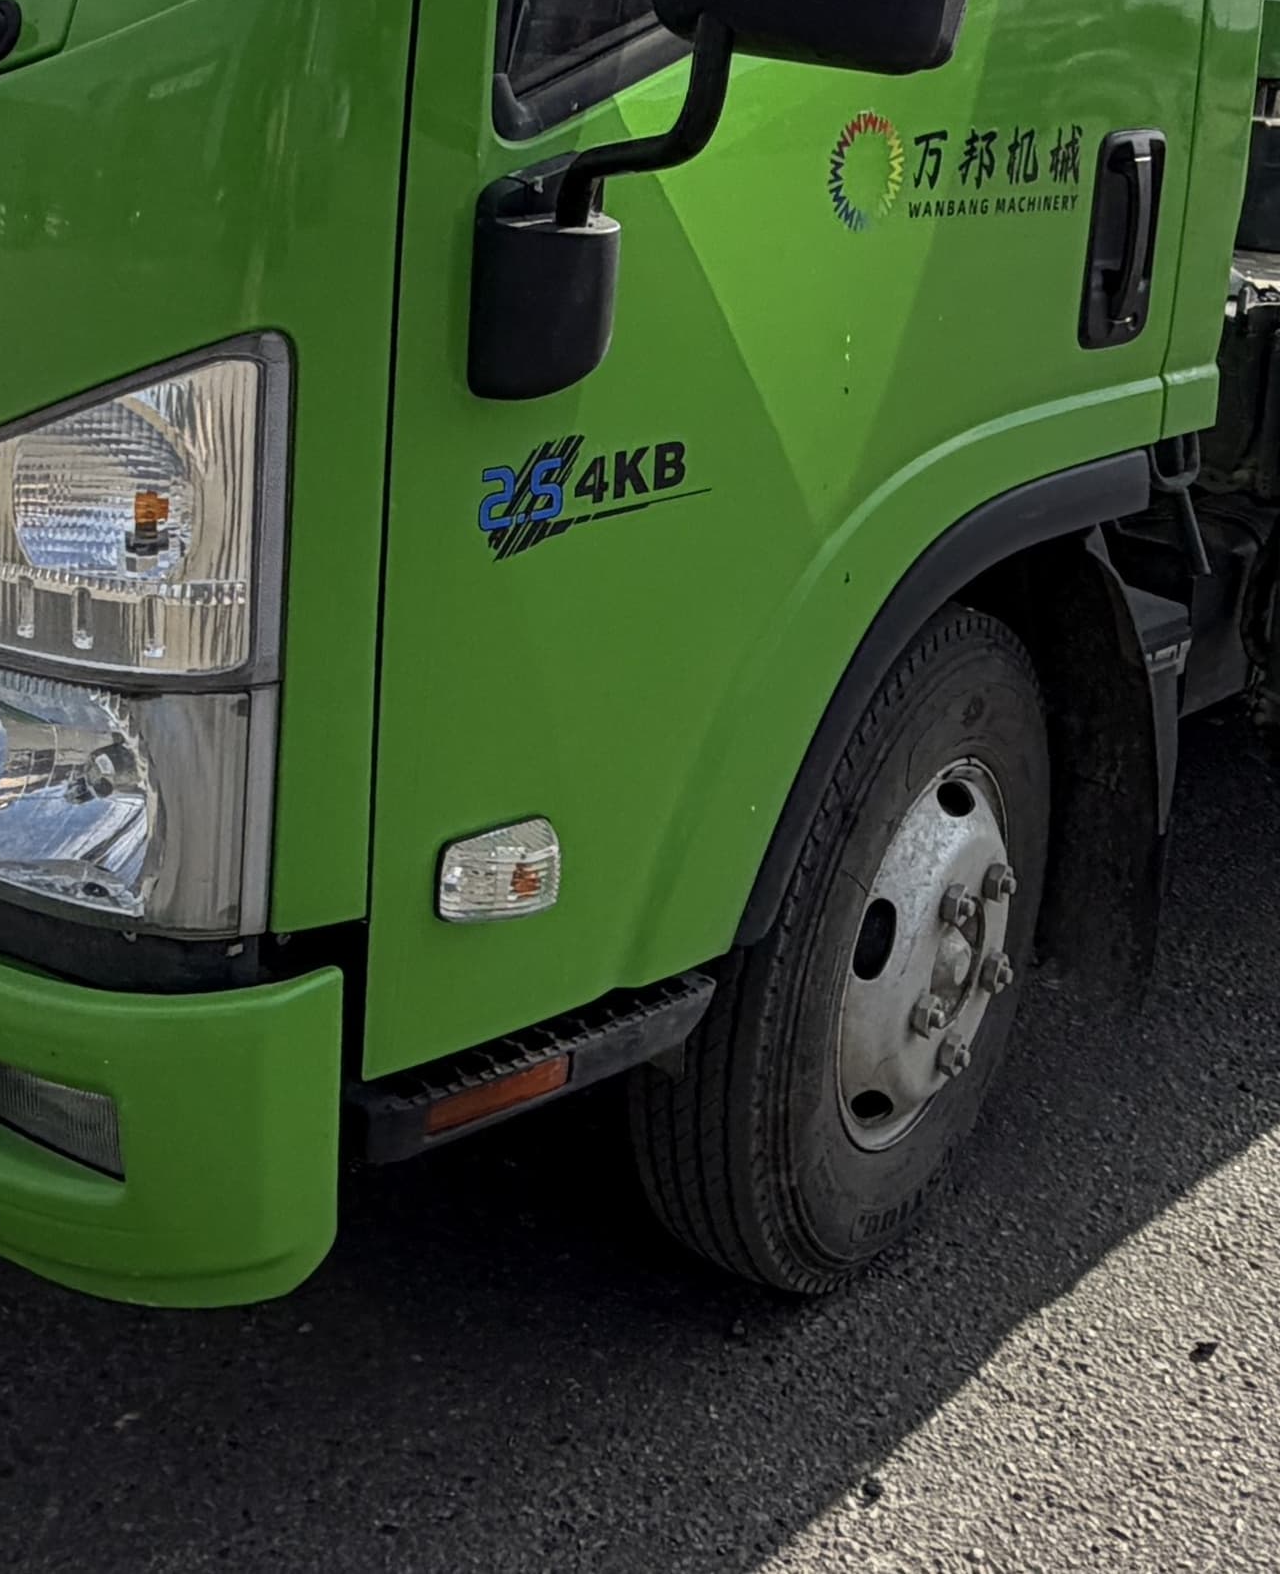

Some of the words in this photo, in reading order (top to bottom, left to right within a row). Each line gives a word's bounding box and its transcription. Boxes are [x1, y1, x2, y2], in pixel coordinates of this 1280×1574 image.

[913, 123, 1084, 190] 万邦机械
[908, 197, 990, 219] WANBANG
[994, 193, 1079, 213] MACHINERY
[574, 440, 687, 504] 4KB
